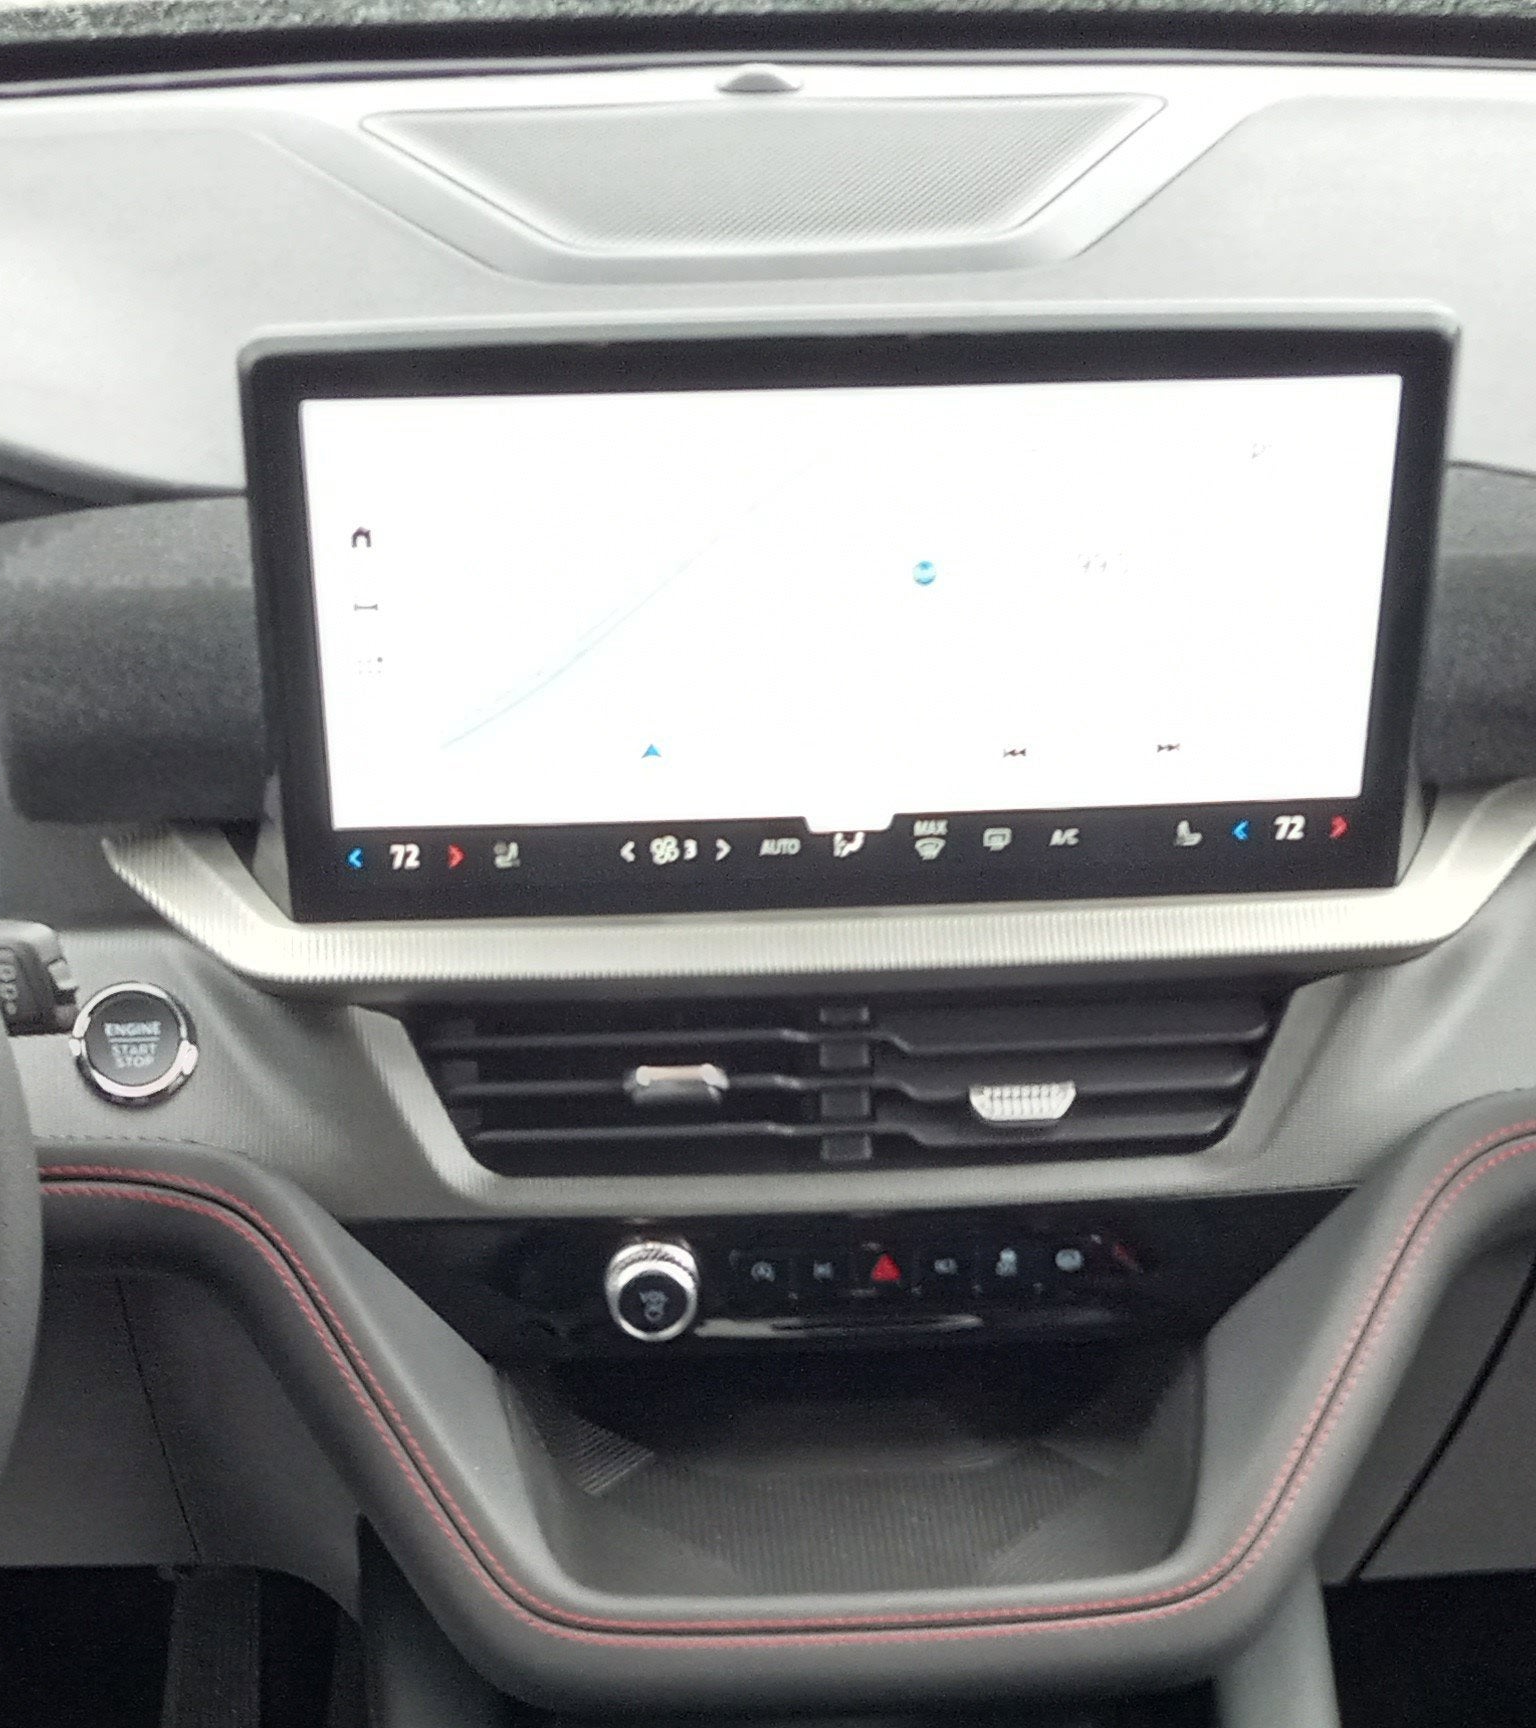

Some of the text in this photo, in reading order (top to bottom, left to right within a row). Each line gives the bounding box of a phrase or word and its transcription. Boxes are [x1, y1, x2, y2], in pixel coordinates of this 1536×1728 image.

[1274, 815, 1305, 840] 72
[390, 844, 420, 869] 72
[683, 838, 698, 861] 3
[759, 837, 802, 857] AUTO
[104, 1021, 162, 1037] ENGINE
[111, 1042, 158, 1055] START
[116, 1055, 155, 1068] STOP
